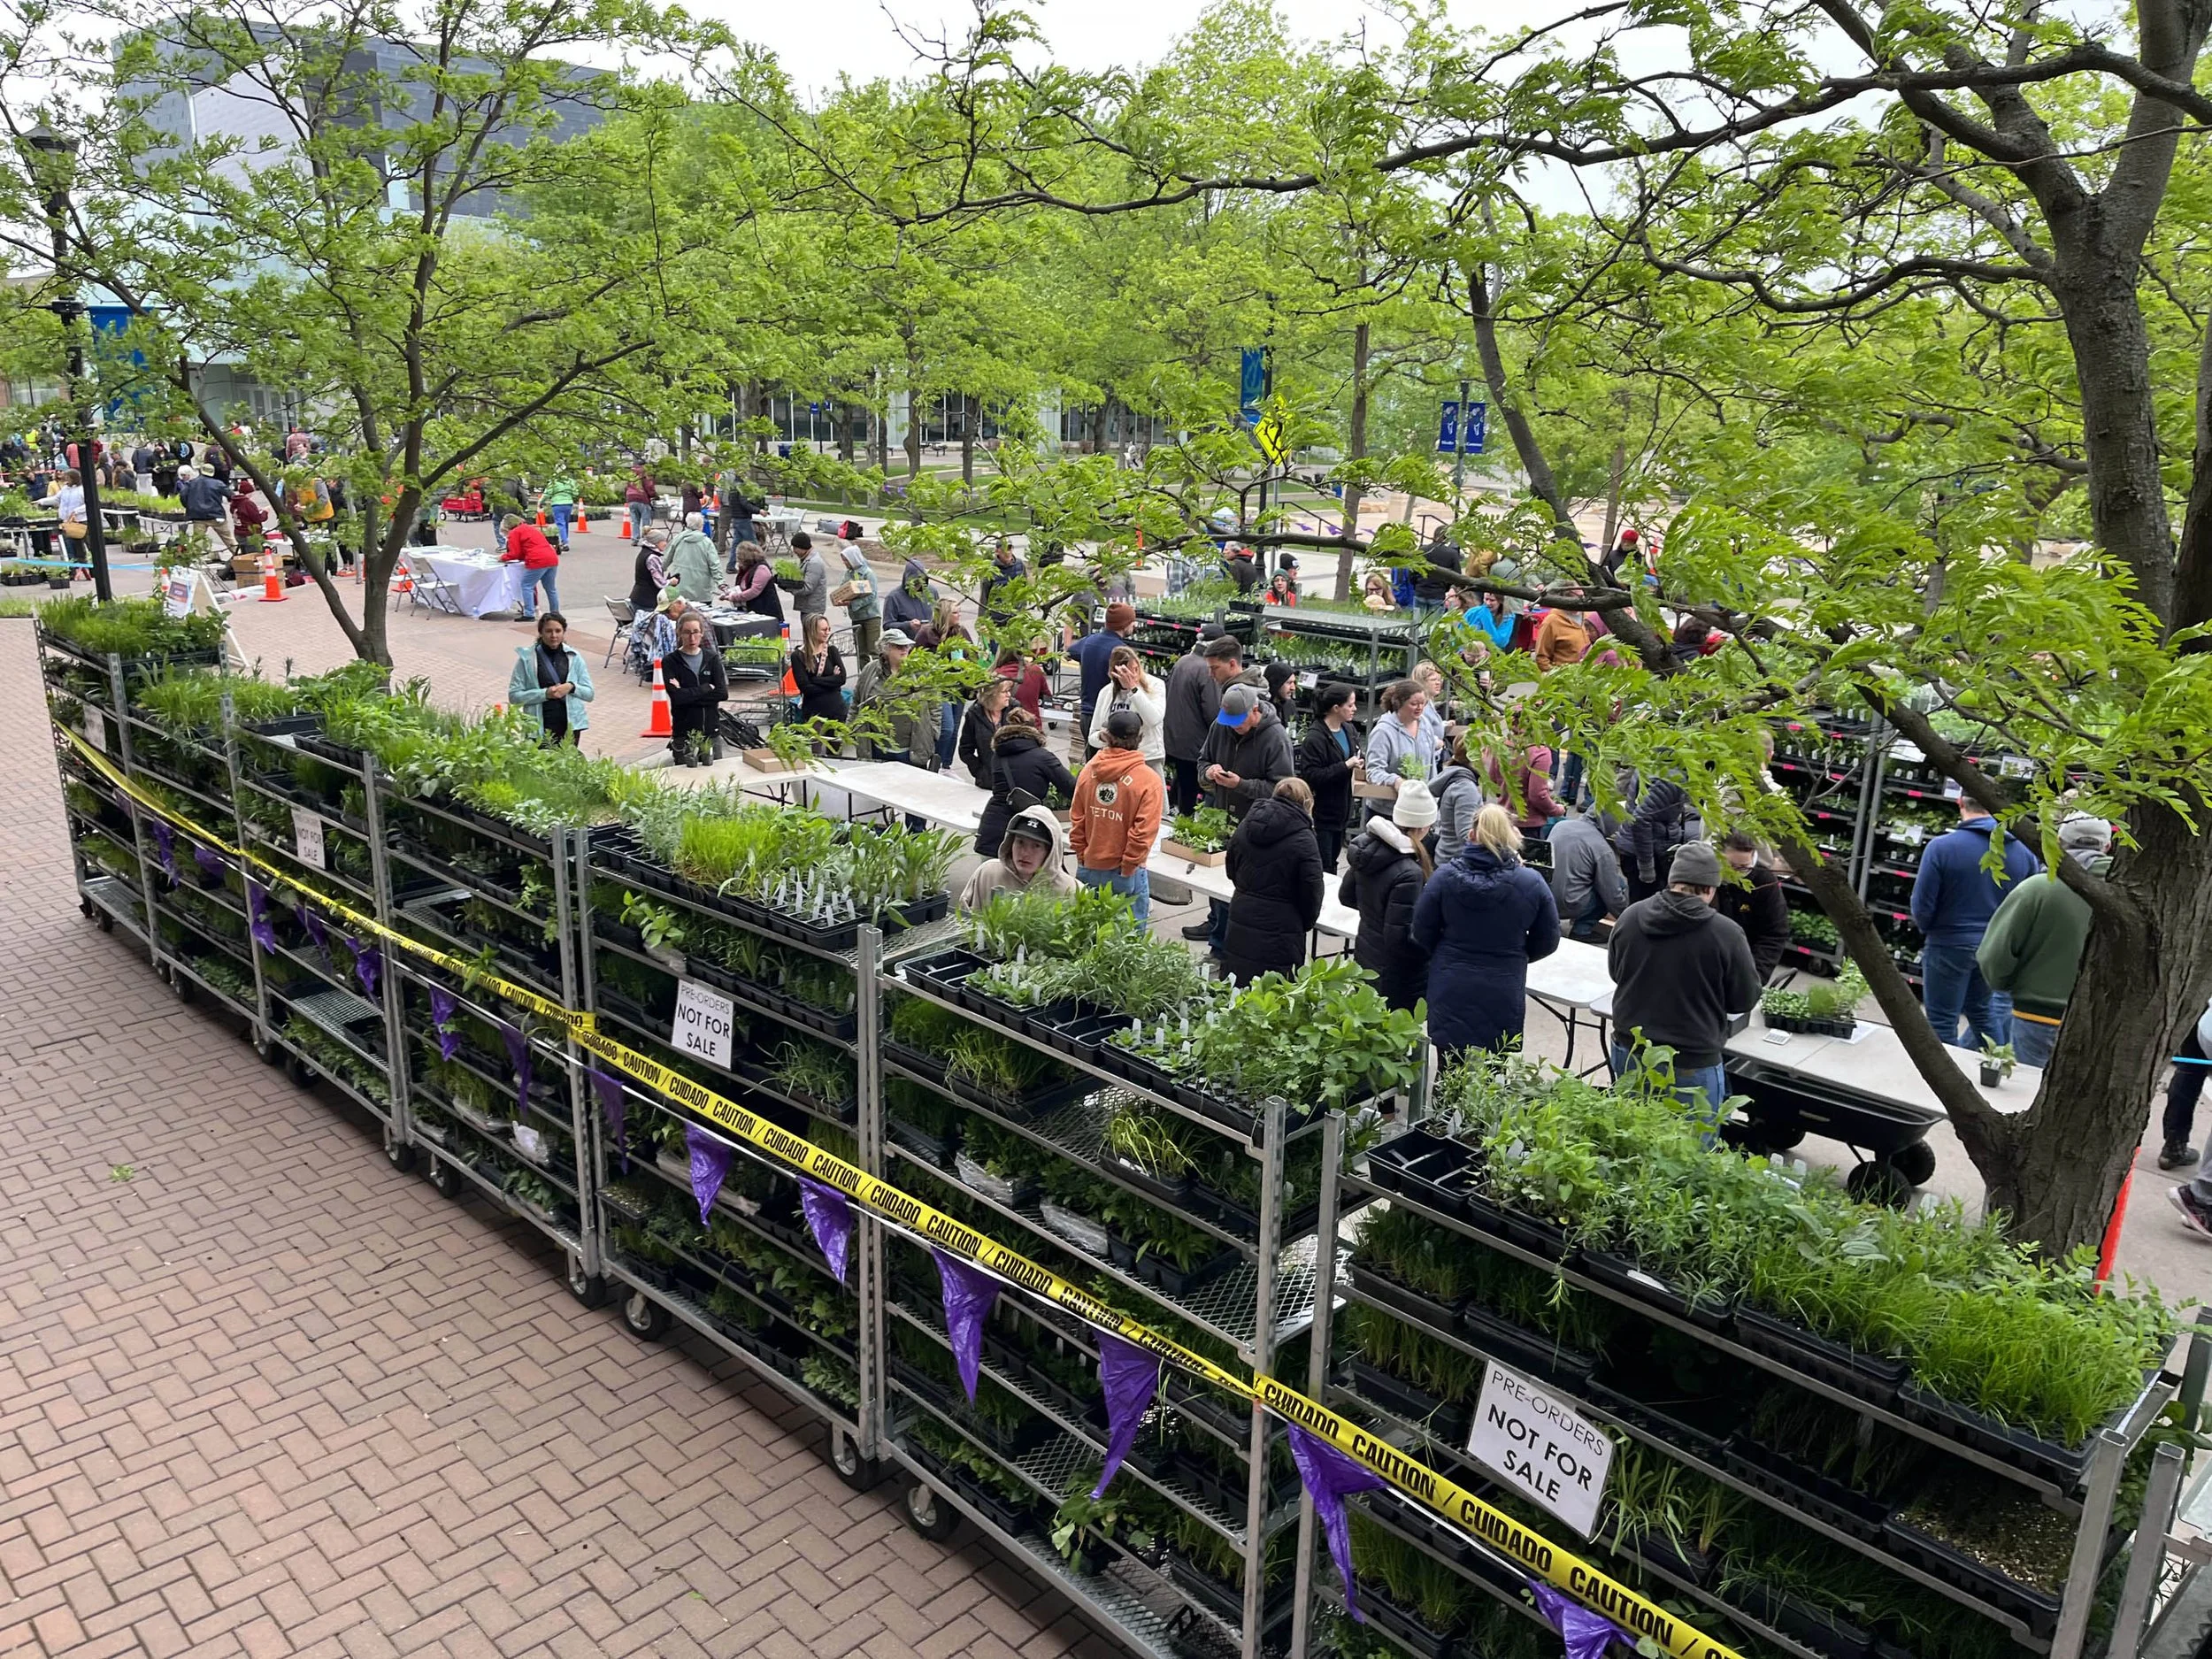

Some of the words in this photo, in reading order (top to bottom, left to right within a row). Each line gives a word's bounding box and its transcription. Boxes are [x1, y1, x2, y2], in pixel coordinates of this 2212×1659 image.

[1090, 806, 1123, 821] TETON
[678, 1003, 702, 1026] NOT
[705, 1015, 730, 1039] FOR
[680, 984, 730, 1015] PRE-ORDERS
[687, 1032, 716, 1056] SALE
[623, 1051, 662, 1085] CAUTION
[669, 1077, 710, 1110] CUIDADO
[712, 1101, 757, 1135] CAUTION
[764, 1127, 809, 1164] CUIDADO
[812, 1154, 862, 1192] CAUTION
[871, 1185, 922, 1225] CUIDADO
[926, 1214, 983, 1257] CAUTION
[993, 1250, 1054, 1294] CUIDADO
[1492, 1371, 1605, 1456] PRE-ORDERS
[1487, 1403, 1540, 1450] NOT
[1543, 1441, 1593, 1491] FOR
[1502, 1449, 1561, 1502] SALE
[1263, 1383, 1340, 1440] CUIDADO
[1351, 1433, 1437, 1502] CAUTION
[1460, 1499, 1553, 1572] CUIDADO
[1569, 1565, 1674, 1648] CAUTION
